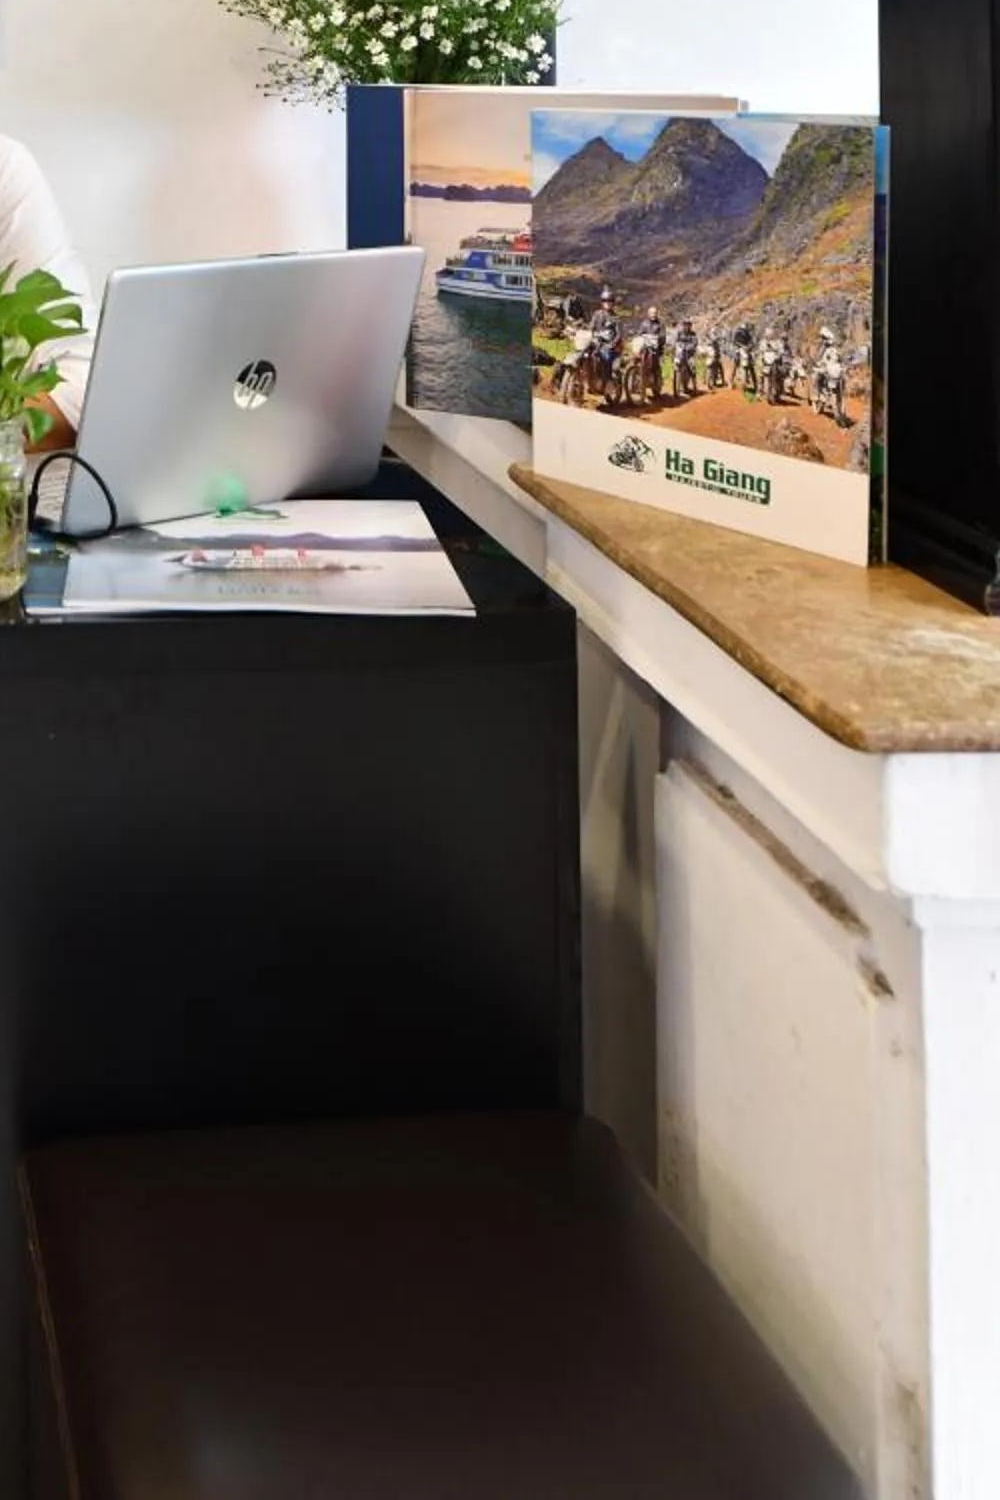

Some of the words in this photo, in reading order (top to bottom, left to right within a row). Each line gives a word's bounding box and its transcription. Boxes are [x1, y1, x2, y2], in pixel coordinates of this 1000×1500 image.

[234, 359, 276, 410] hp
[665, 448, 695, 476] Ha
[703, 457, 771, 506] Giang
